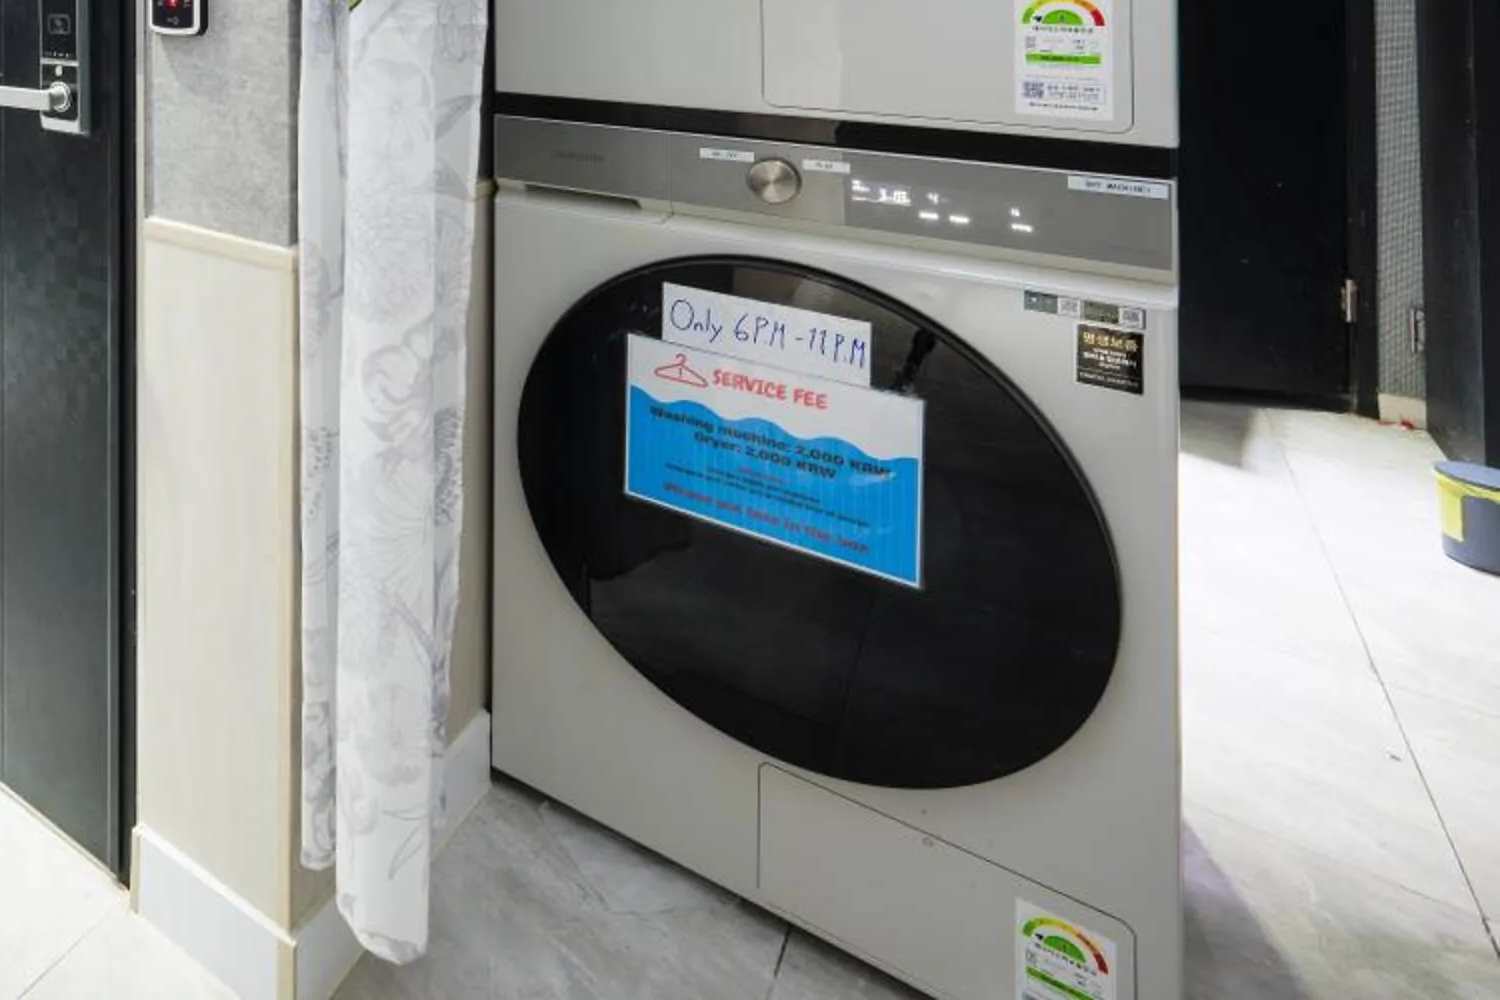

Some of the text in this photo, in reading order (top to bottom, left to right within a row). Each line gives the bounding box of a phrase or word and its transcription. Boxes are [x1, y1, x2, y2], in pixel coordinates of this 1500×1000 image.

[670, 299, 723, 343] Only
[712, 369, 828, 409] SERVICE FEE
[650, 406, 714, 433] Washing
[694, 432, 742, 453] Dryer:
[796, 460, 838, 479] KRW
